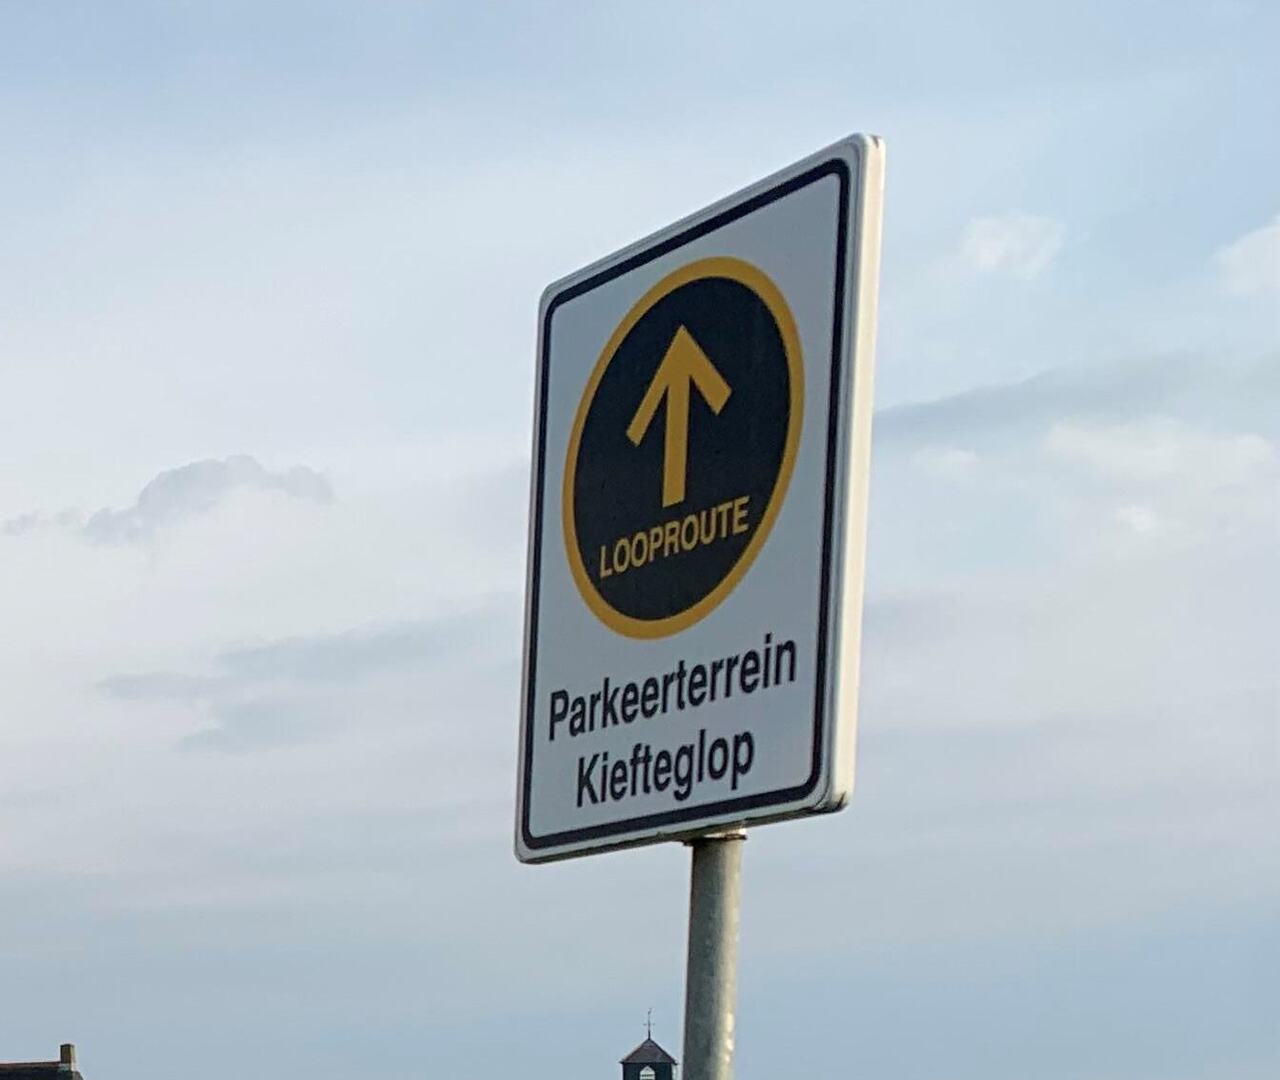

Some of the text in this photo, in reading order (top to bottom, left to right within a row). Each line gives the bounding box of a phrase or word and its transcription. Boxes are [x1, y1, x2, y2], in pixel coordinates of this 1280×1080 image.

[600, 495, 750, 579] LOOPROUTE
[548, 632, 797, 742] Parkeerterrein
[576, 728, 755, 809] Kiefteglop
